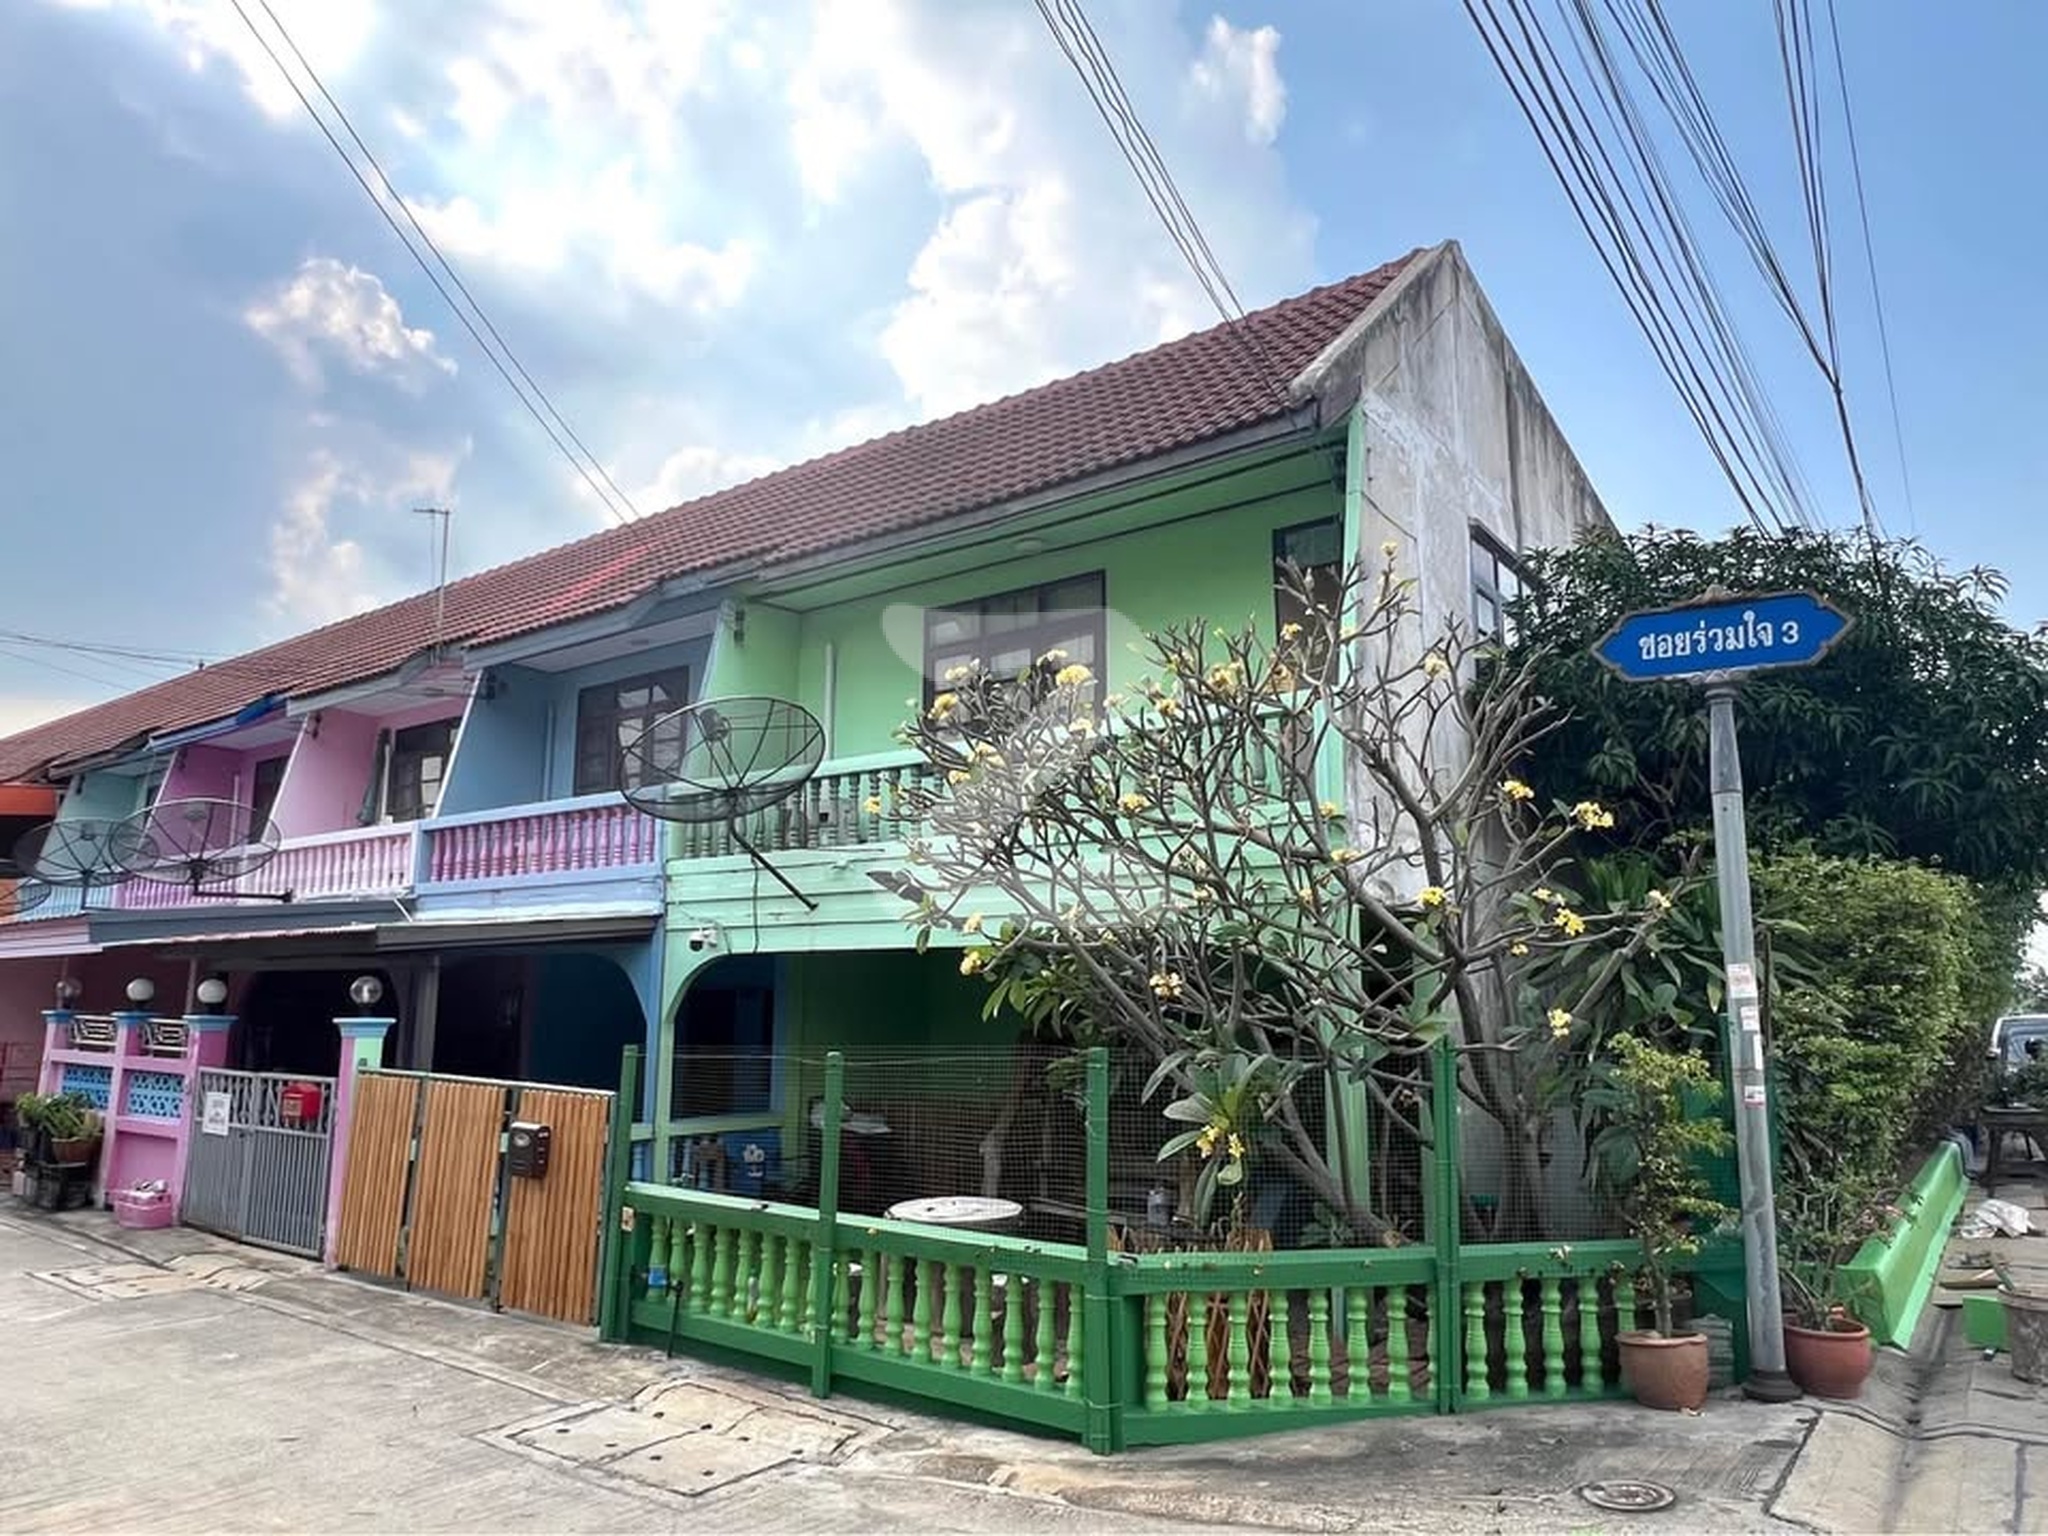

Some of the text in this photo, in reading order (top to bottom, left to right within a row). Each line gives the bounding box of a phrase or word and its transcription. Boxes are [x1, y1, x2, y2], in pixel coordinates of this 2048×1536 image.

[1638, 610, 1799, 660] ซอยร่วมใจ 3
